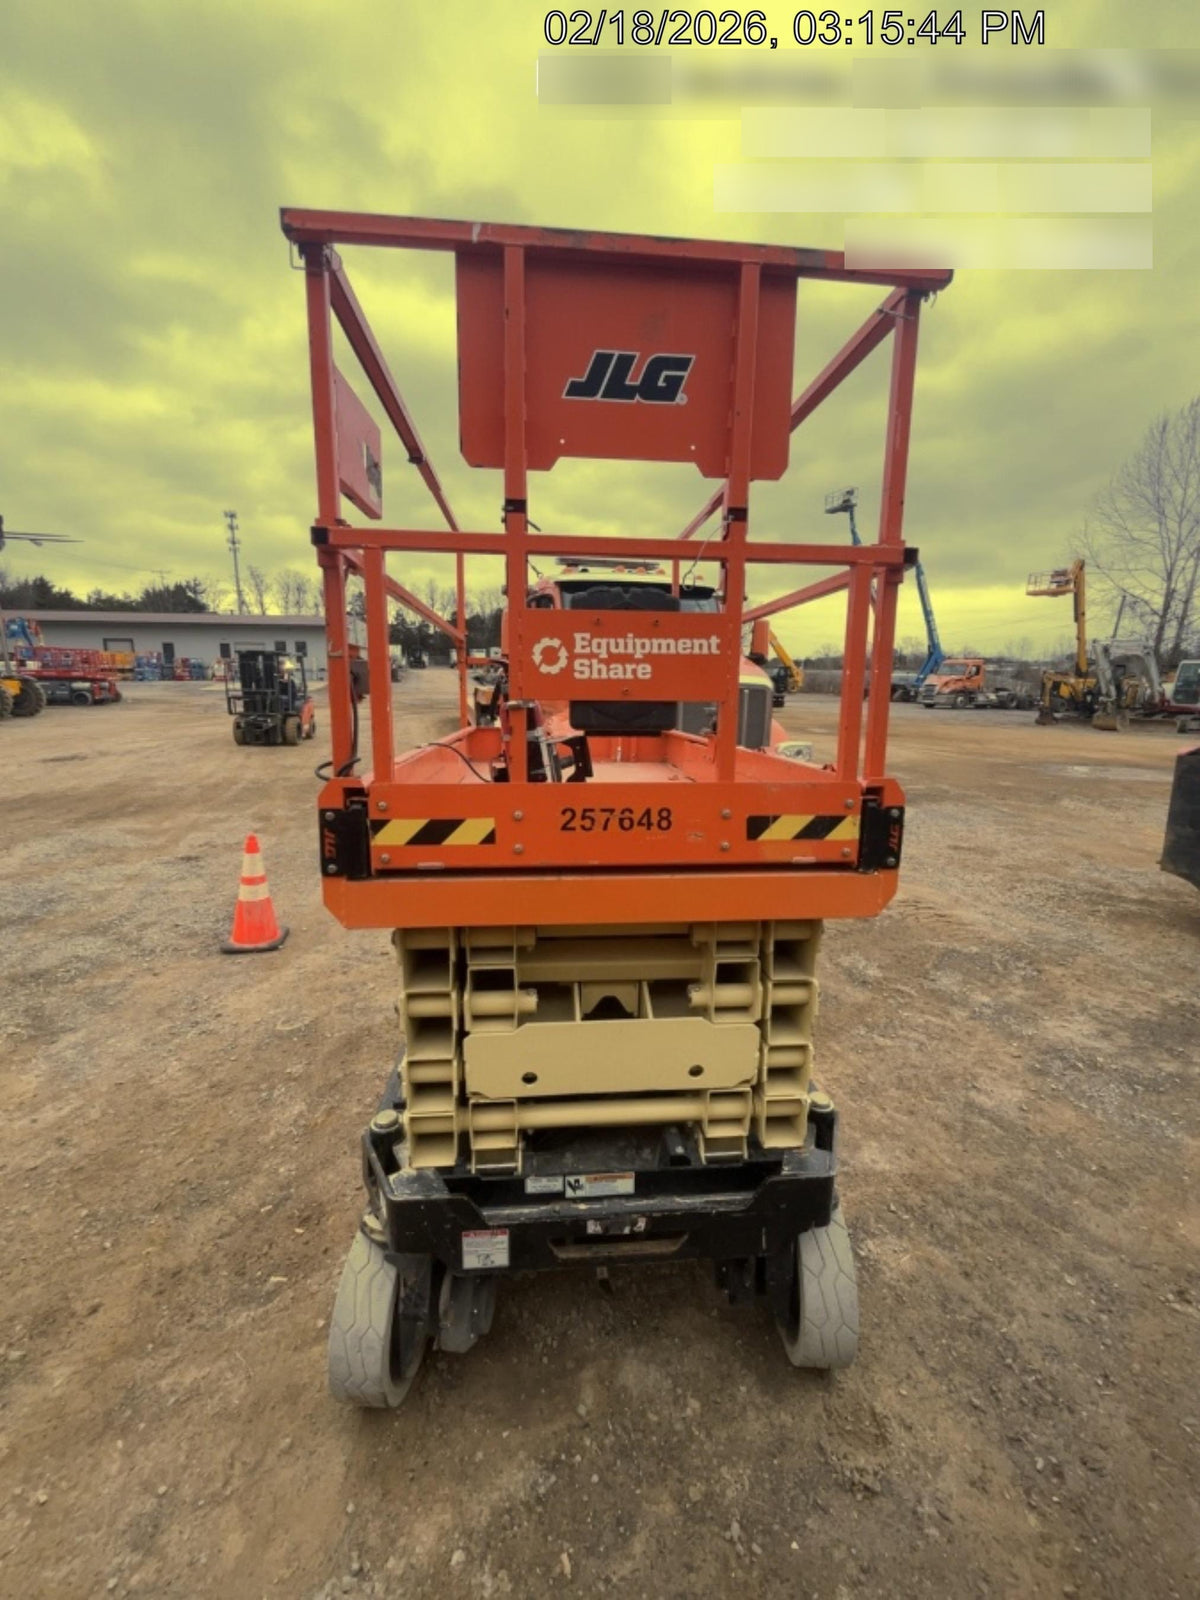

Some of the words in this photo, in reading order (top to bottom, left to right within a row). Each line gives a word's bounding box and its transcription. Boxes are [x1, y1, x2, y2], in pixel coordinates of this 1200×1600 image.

[561, 349, 696, 405] JLG
[573, 632, 721, 659] Equipment
[573, 658, 653, 680] Share
[560, 806, 673, 832] 257648
